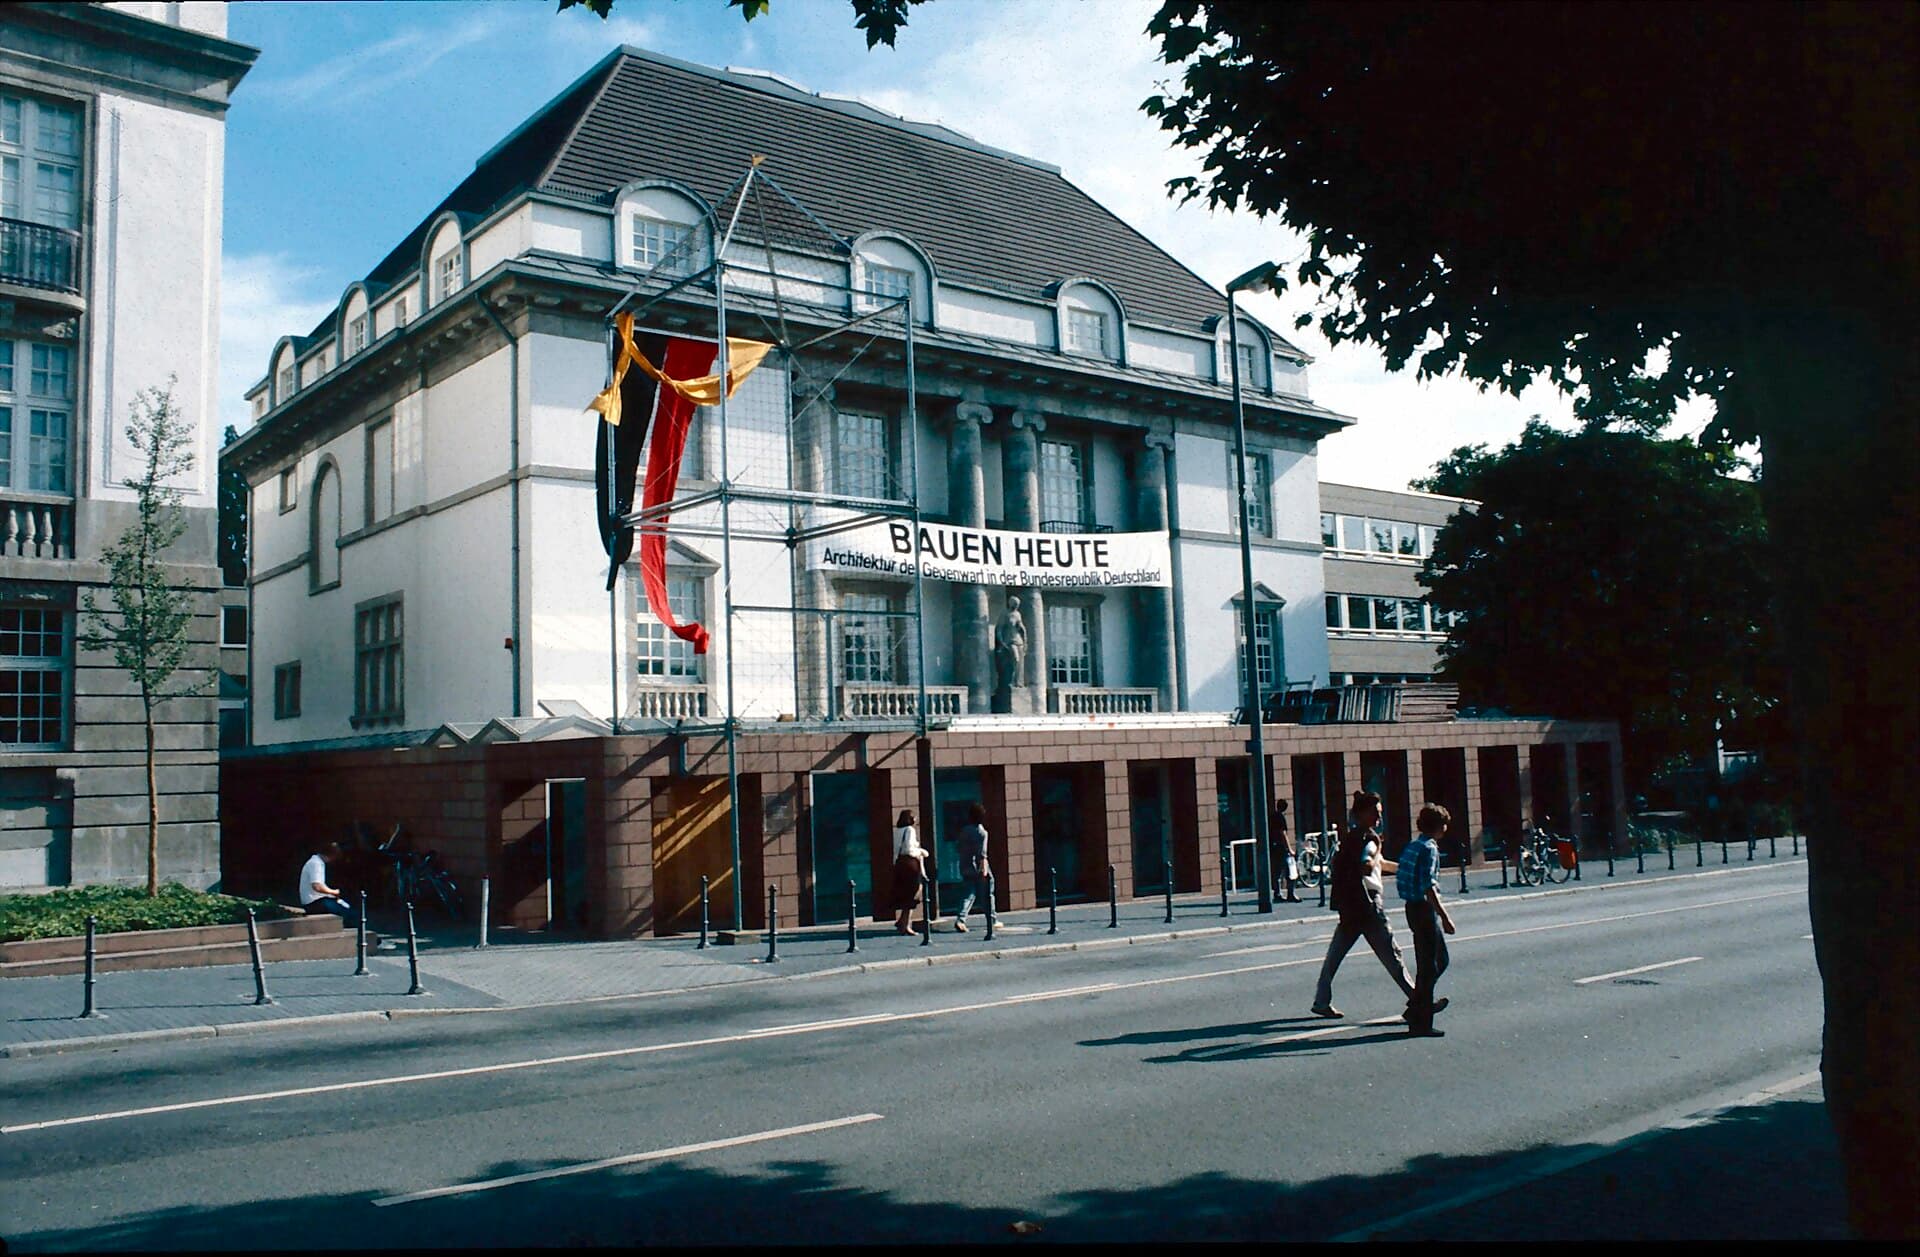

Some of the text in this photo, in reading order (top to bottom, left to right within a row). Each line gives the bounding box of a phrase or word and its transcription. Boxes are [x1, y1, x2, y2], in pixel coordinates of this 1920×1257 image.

[823, 547, 1161, 587] Architektur de Gegenwart in der Bundesrepublik Deutschland
[1014, 537, 1109, 568] HEUTE
